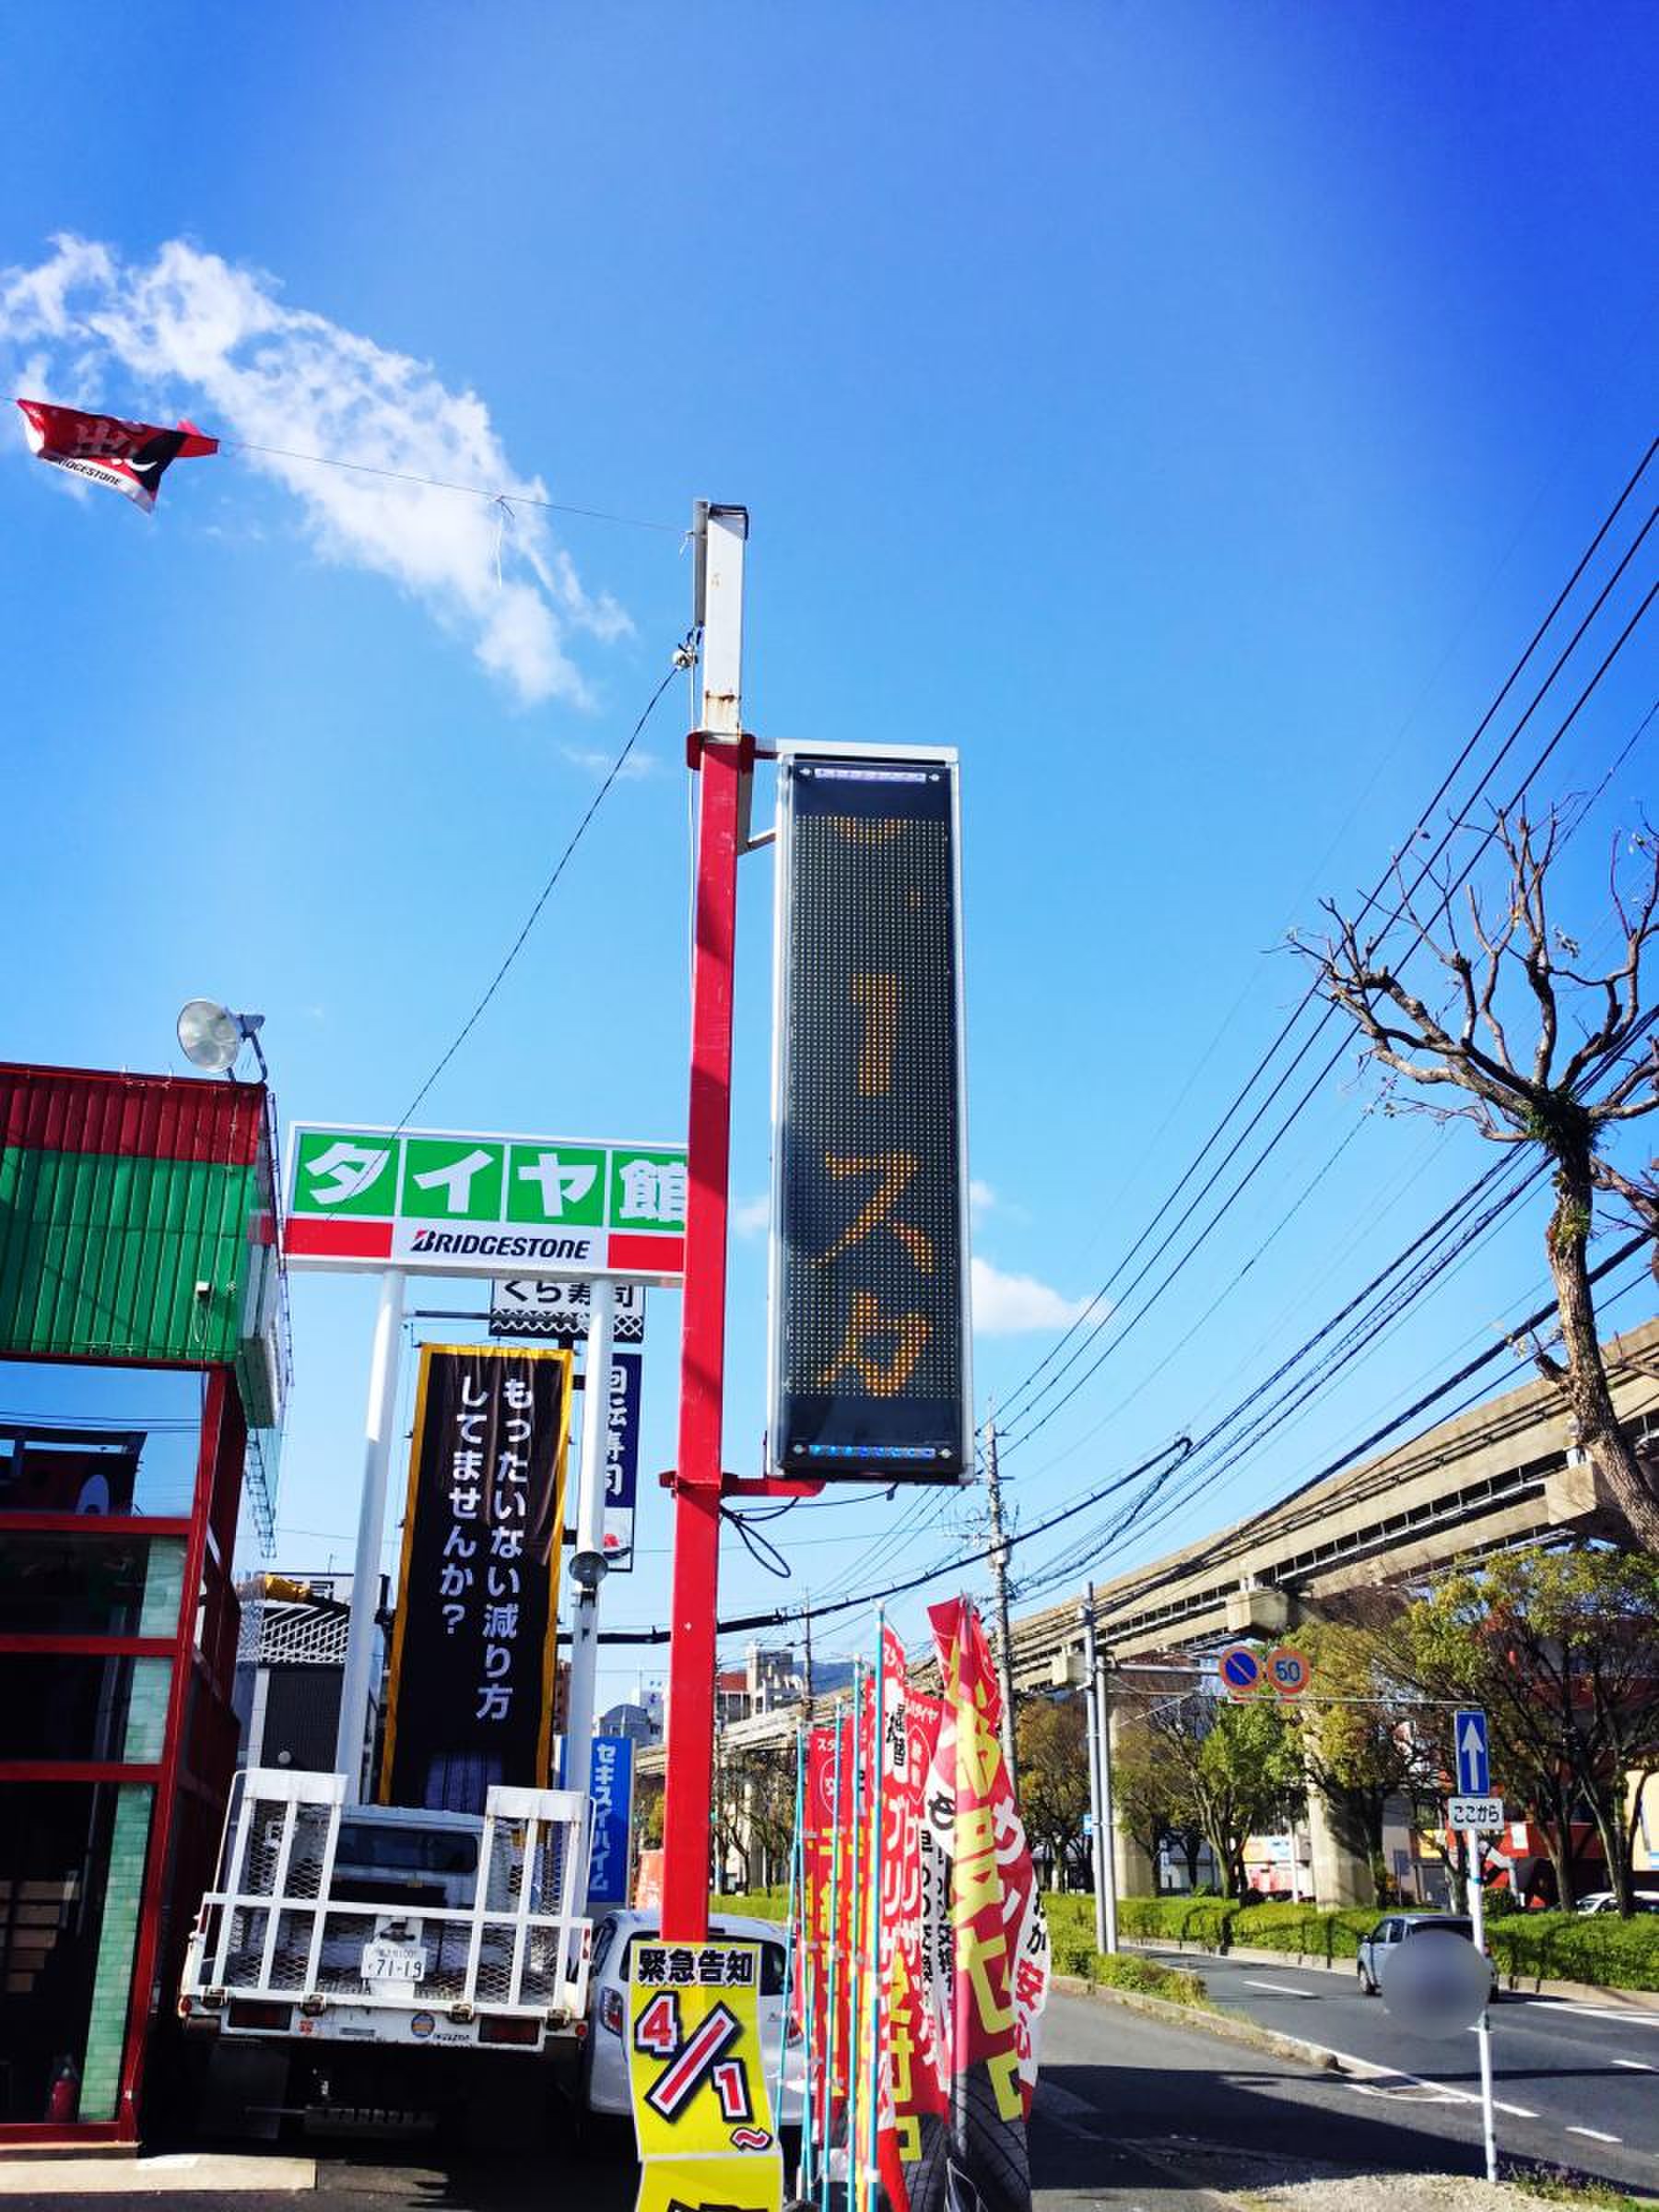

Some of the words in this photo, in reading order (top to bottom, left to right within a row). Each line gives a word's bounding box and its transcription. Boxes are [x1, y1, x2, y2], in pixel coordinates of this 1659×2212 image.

[305, 1142, 686, 1223] タイヤ館
[410, 1230, 591, 1261] BRIDGESTONE
[440, 1375, 488, 1636] してませんか?
[476, 1378, 534, 1721] もったいない減り方
[1275, 1661, 1300, 1682] 50
[591, 1742, 617, 1891] セキスイハイム
[1453, 1805, 1500, 1823] ここから
[638, 1947, 755, 1985] 緊急告知
